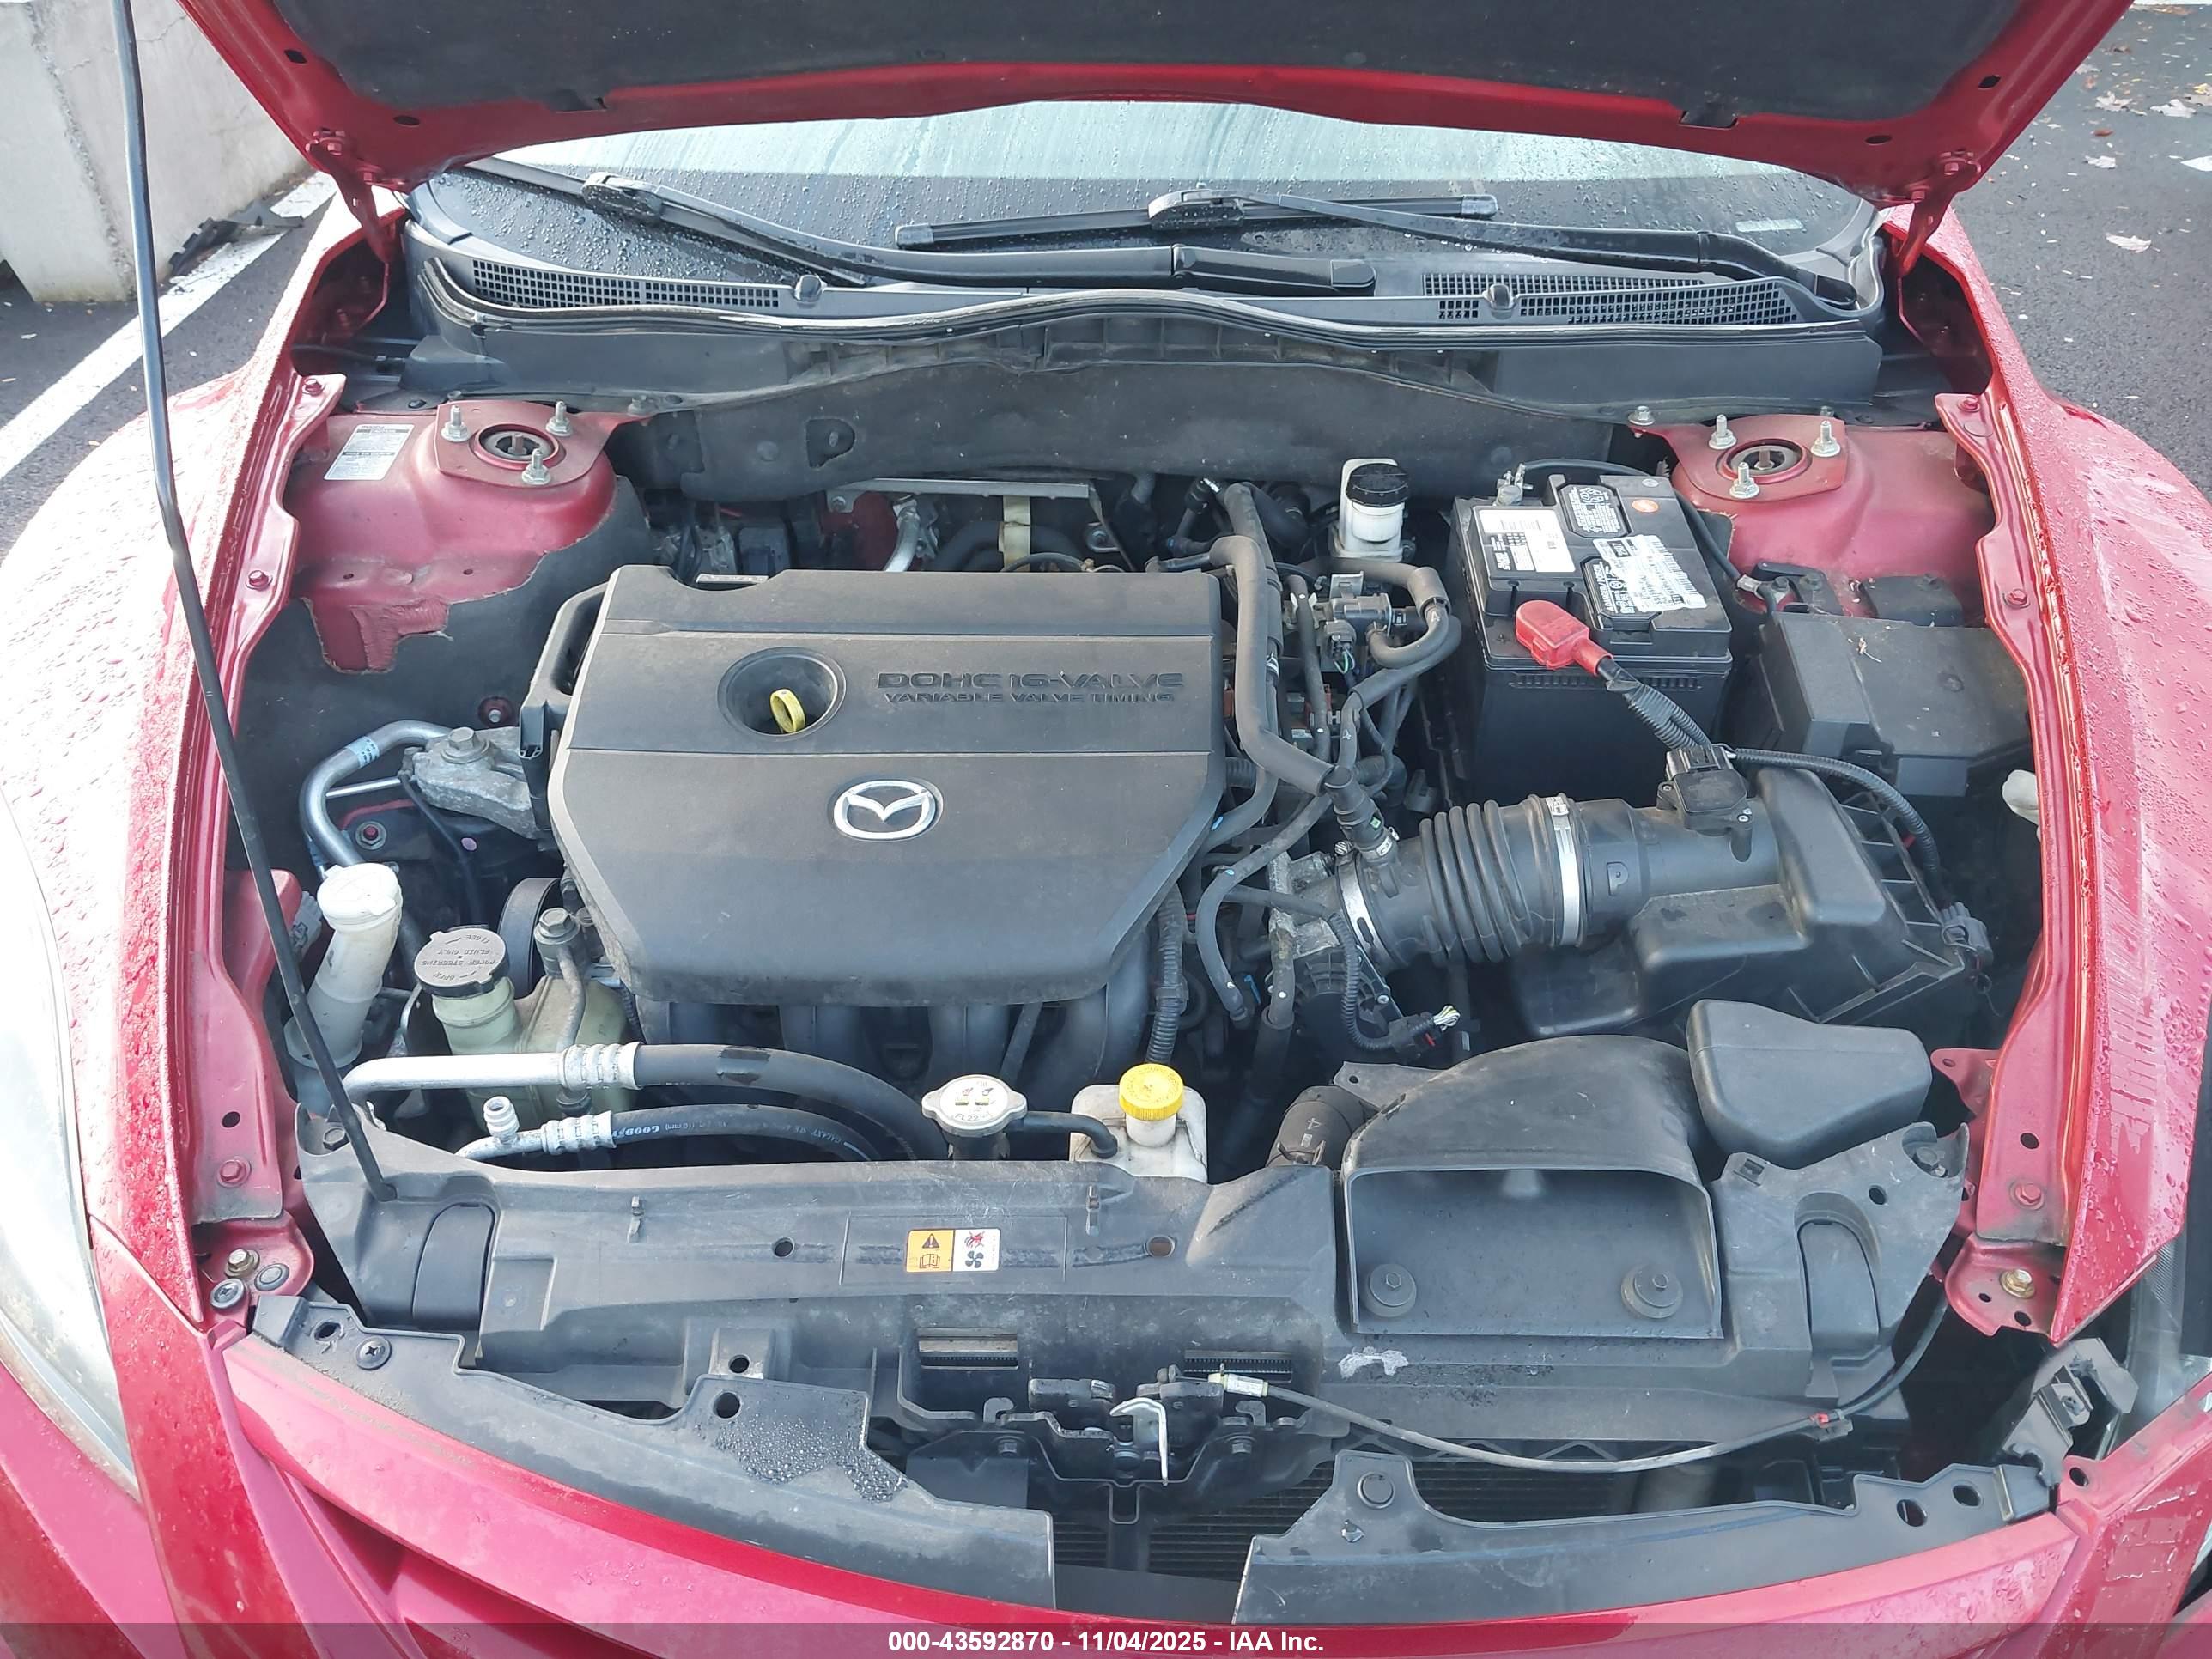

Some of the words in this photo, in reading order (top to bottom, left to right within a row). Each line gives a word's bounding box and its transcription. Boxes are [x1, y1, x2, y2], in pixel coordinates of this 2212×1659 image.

[876, 672, 1001, 689] DOHC
[1009, 672, 1185, 689] 16-VALVE
[883, 693, 1004, 703] VARIABLE
[1011, 693, 1084, 703] VALVE
[1091, 692, 1174, 703] TIMING
